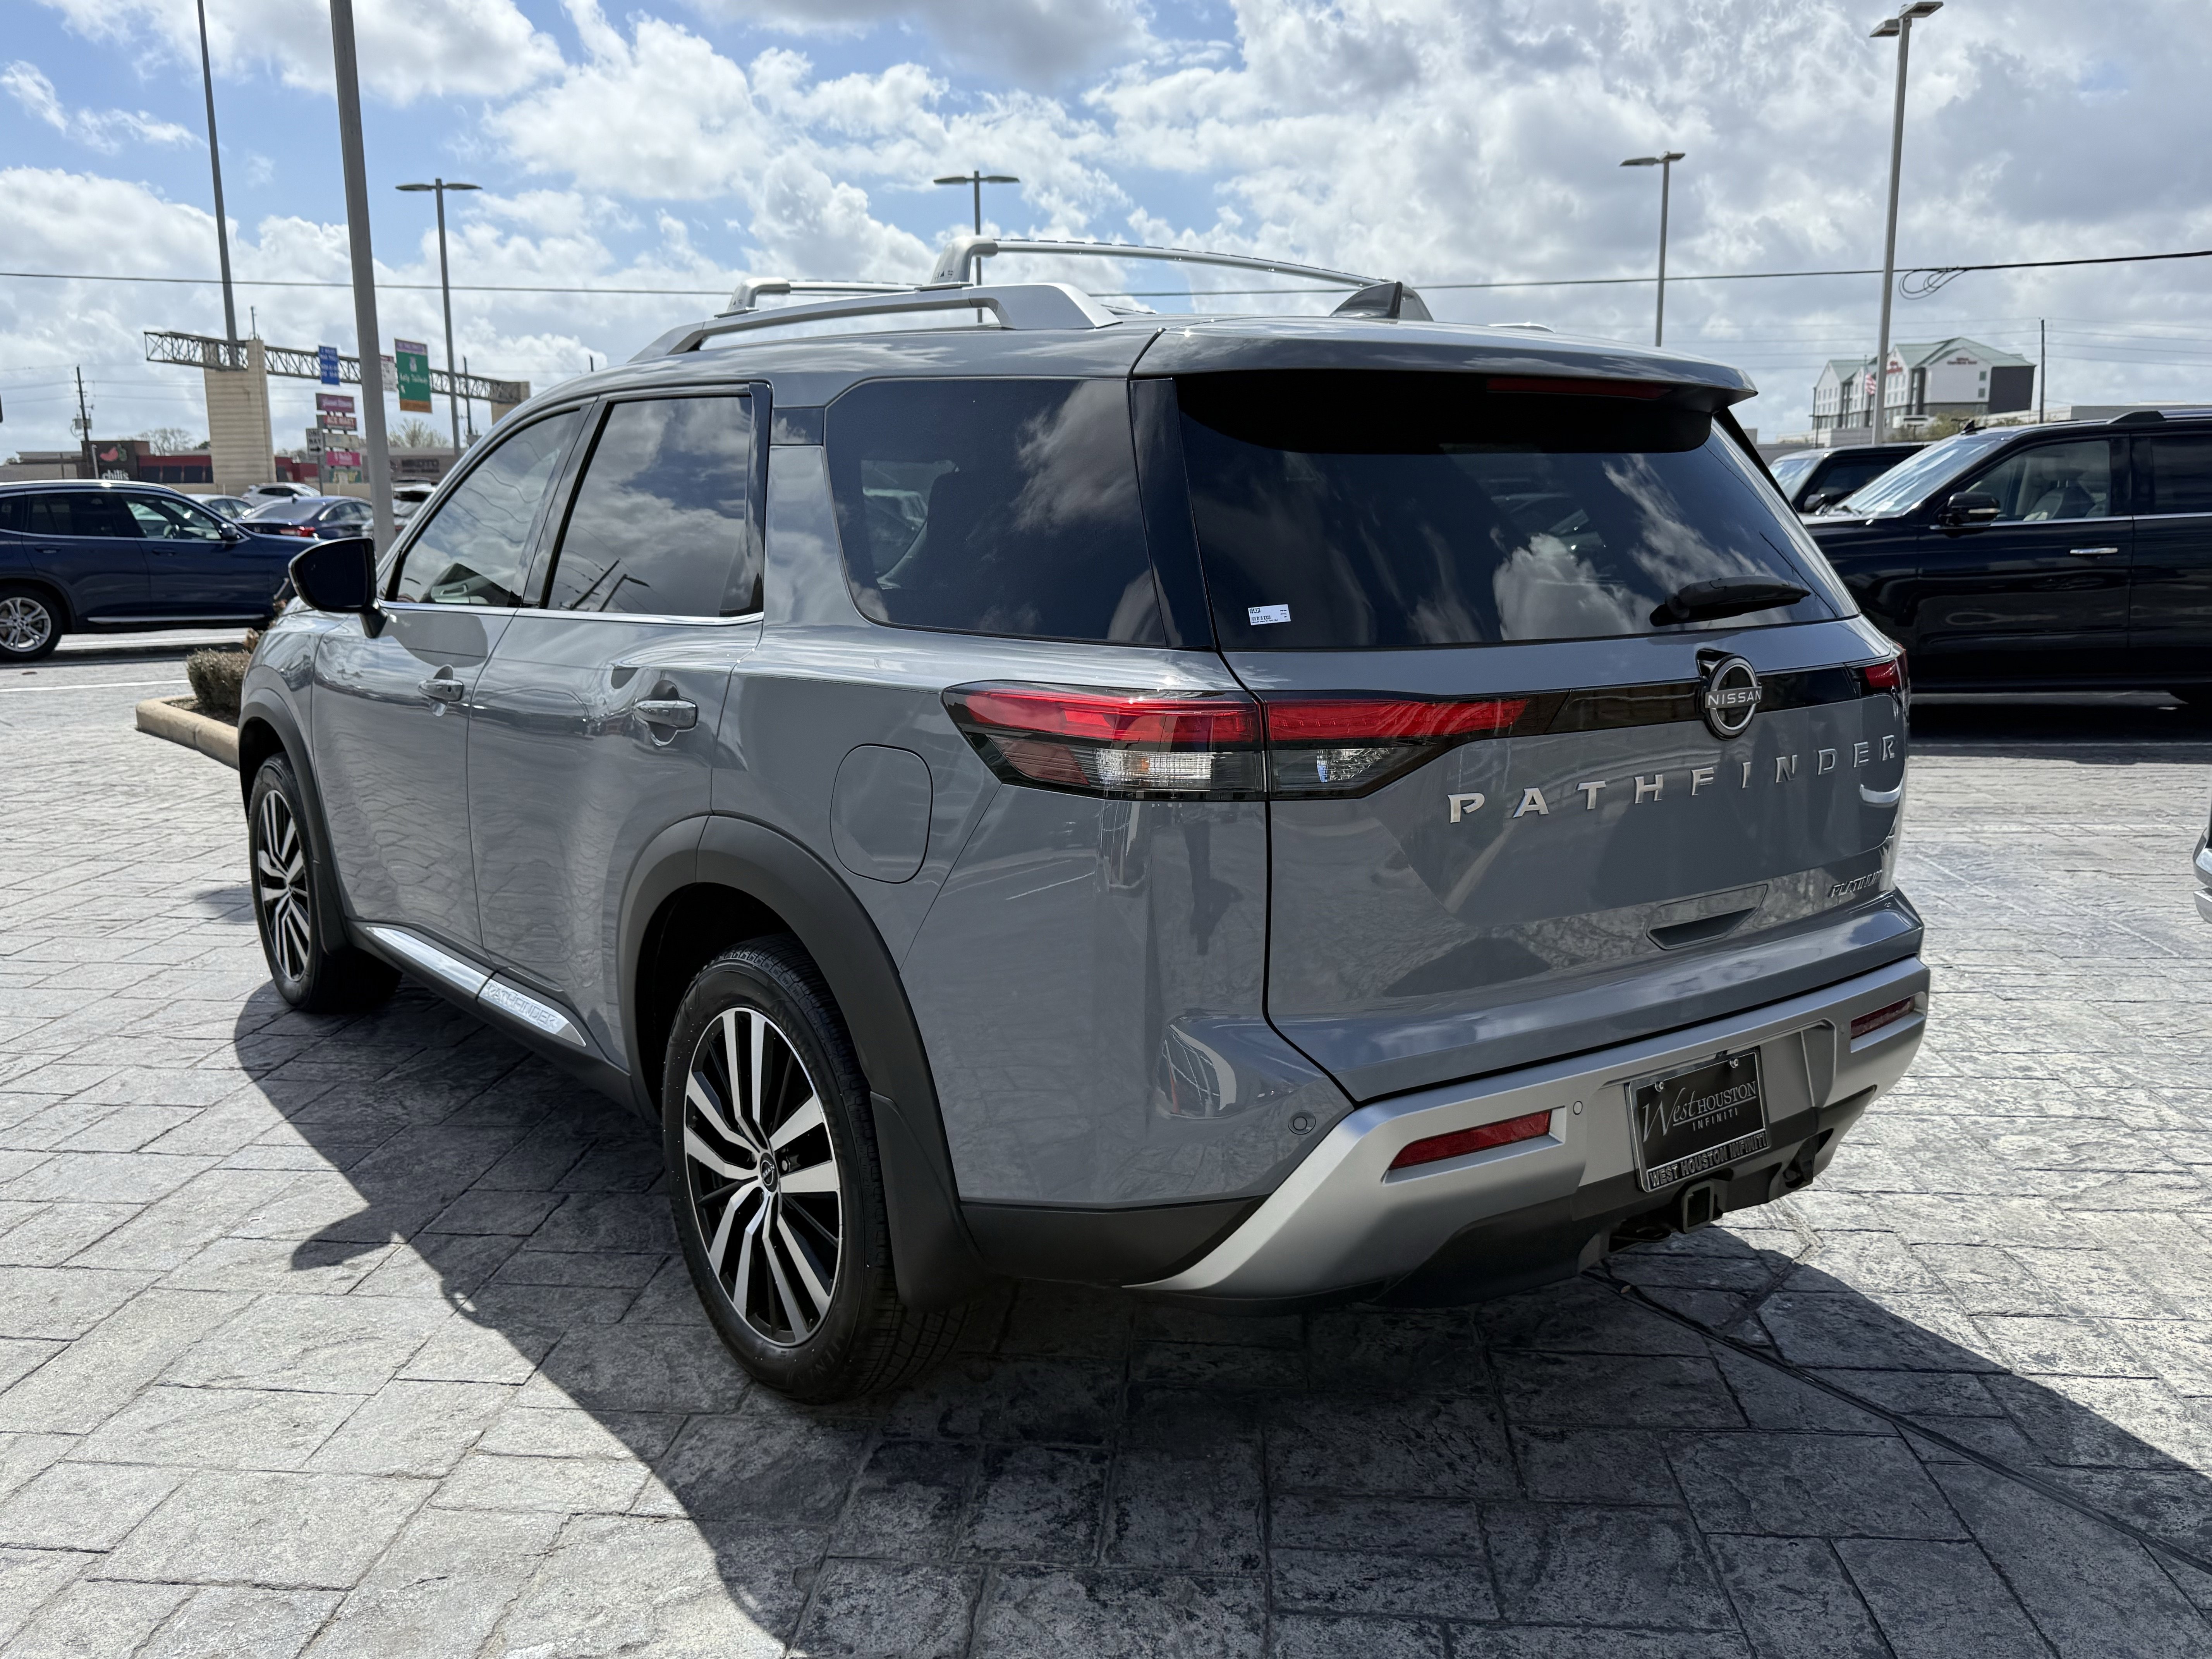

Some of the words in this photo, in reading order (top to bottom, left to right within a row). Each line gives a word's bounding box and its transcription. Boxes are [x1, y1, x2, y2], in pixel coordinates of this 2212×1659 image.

[1707, 690, 1761, 706] NISSAN
[1447, 734, 1895, 824] PATHFINDER
[1692, 1108, 1738, 1131] INFINITI
[1650, 1163, 1678, 1187] WEST
[1681, 1146, 1728, 1176] HOUSTON
[1729, 1132, 1767, 1159] INFINITI
